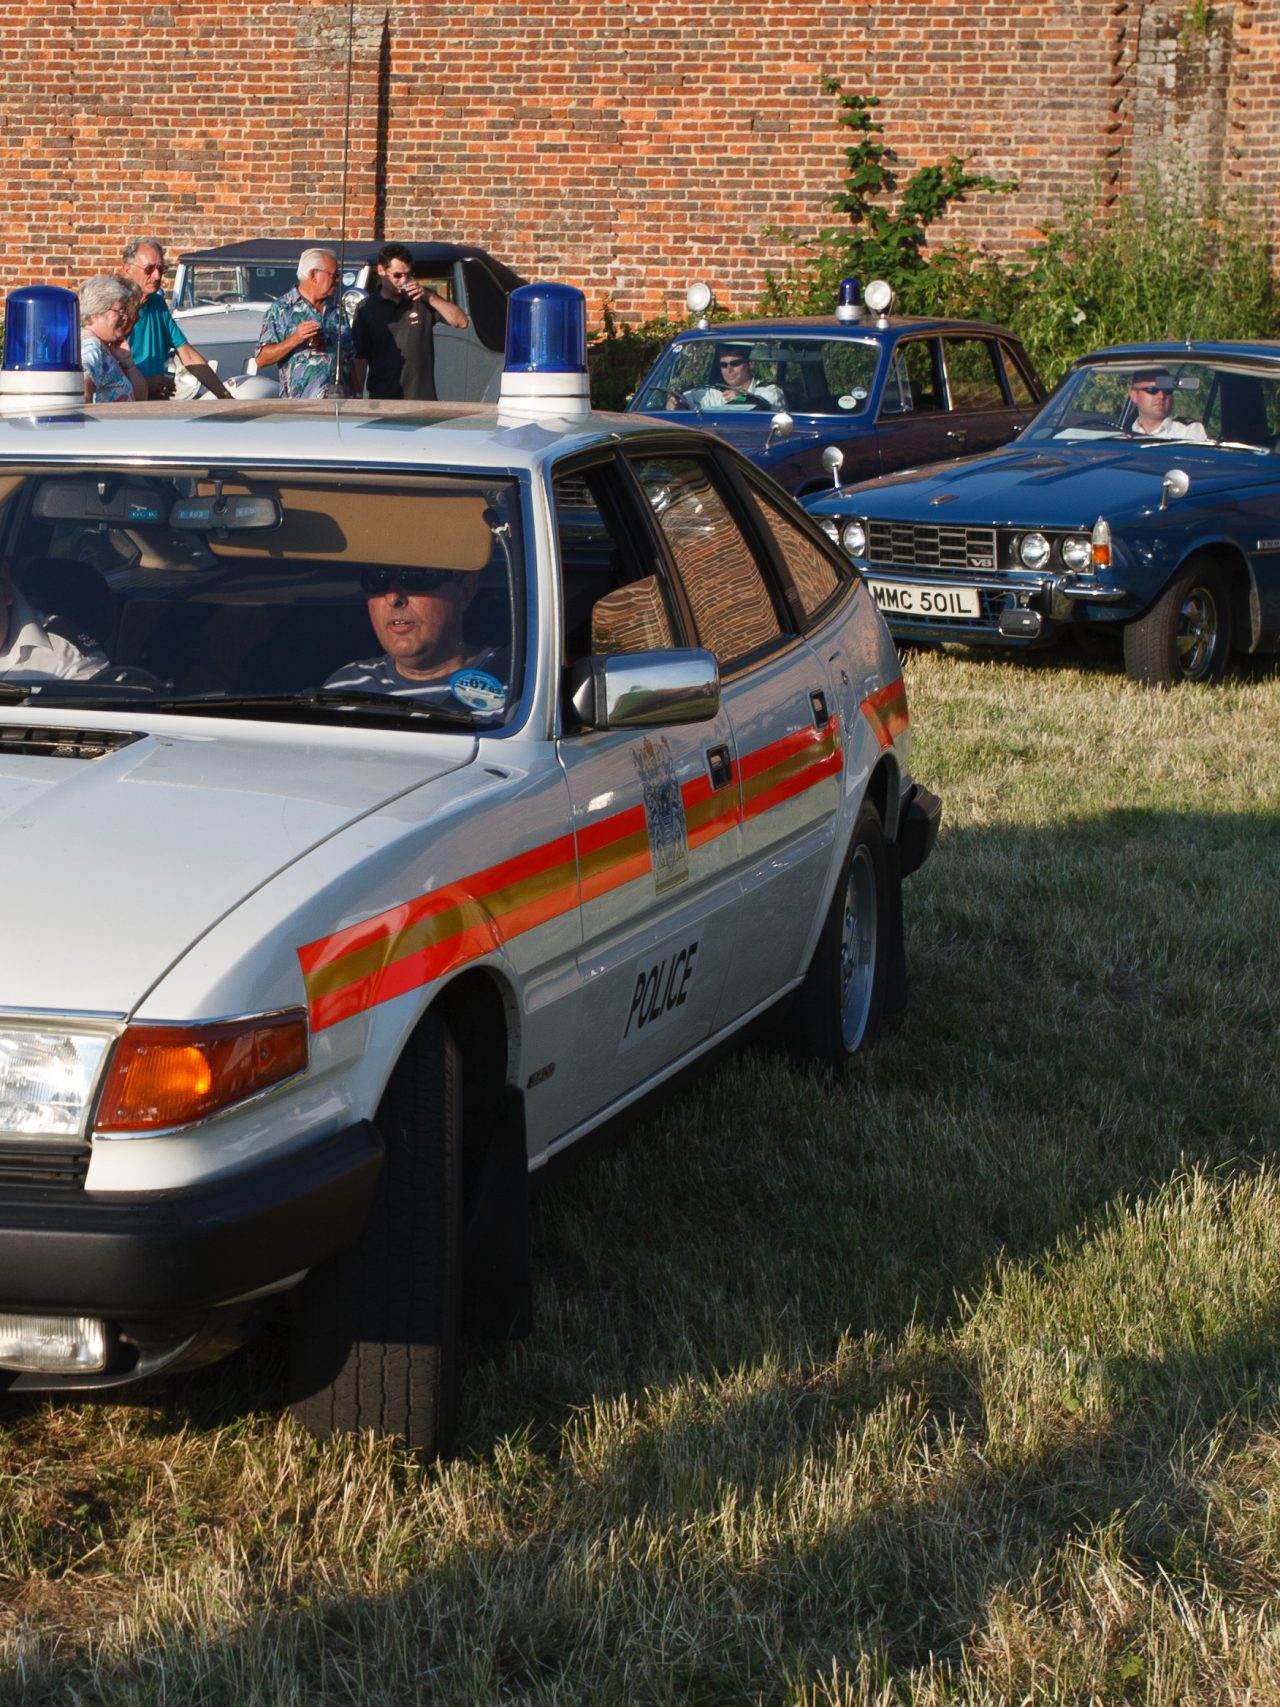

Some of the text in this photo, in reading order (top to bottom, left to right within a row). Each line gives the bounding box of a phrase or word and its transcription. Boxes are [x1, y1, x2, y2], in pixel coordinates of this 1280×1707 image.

[971, 558, 993, 567] V8
[873, 586, 972, 614] MMC 501L
[470, 679, 488, 690] 07
[623, 941, 699, 1039] POLICE
